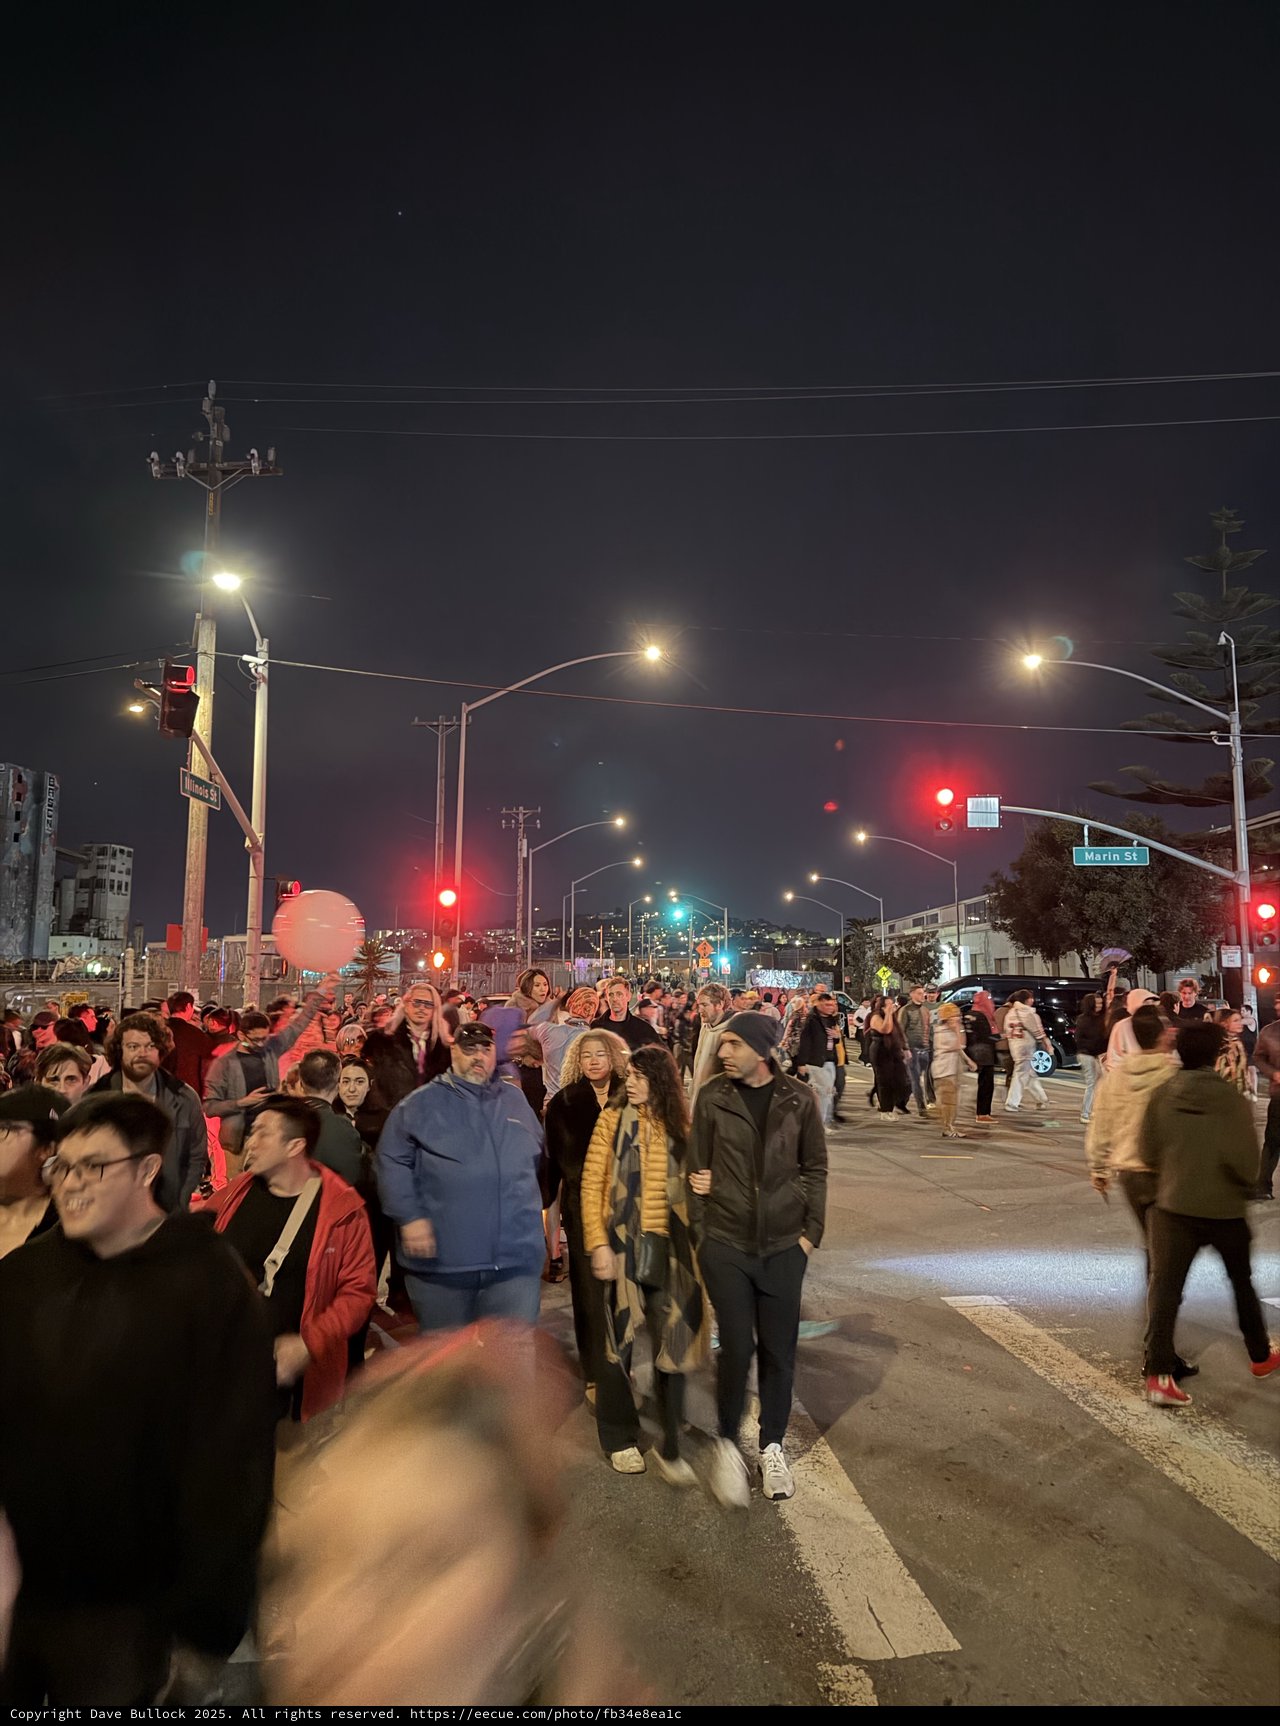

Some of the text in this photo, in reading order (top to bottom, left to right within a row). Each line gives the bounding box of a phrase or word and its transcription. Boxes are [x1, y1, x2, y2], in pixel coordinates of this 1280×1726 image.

[185, 776, 217, 802] Illinois St
[1085, 851, 1138, 861] Marin St
